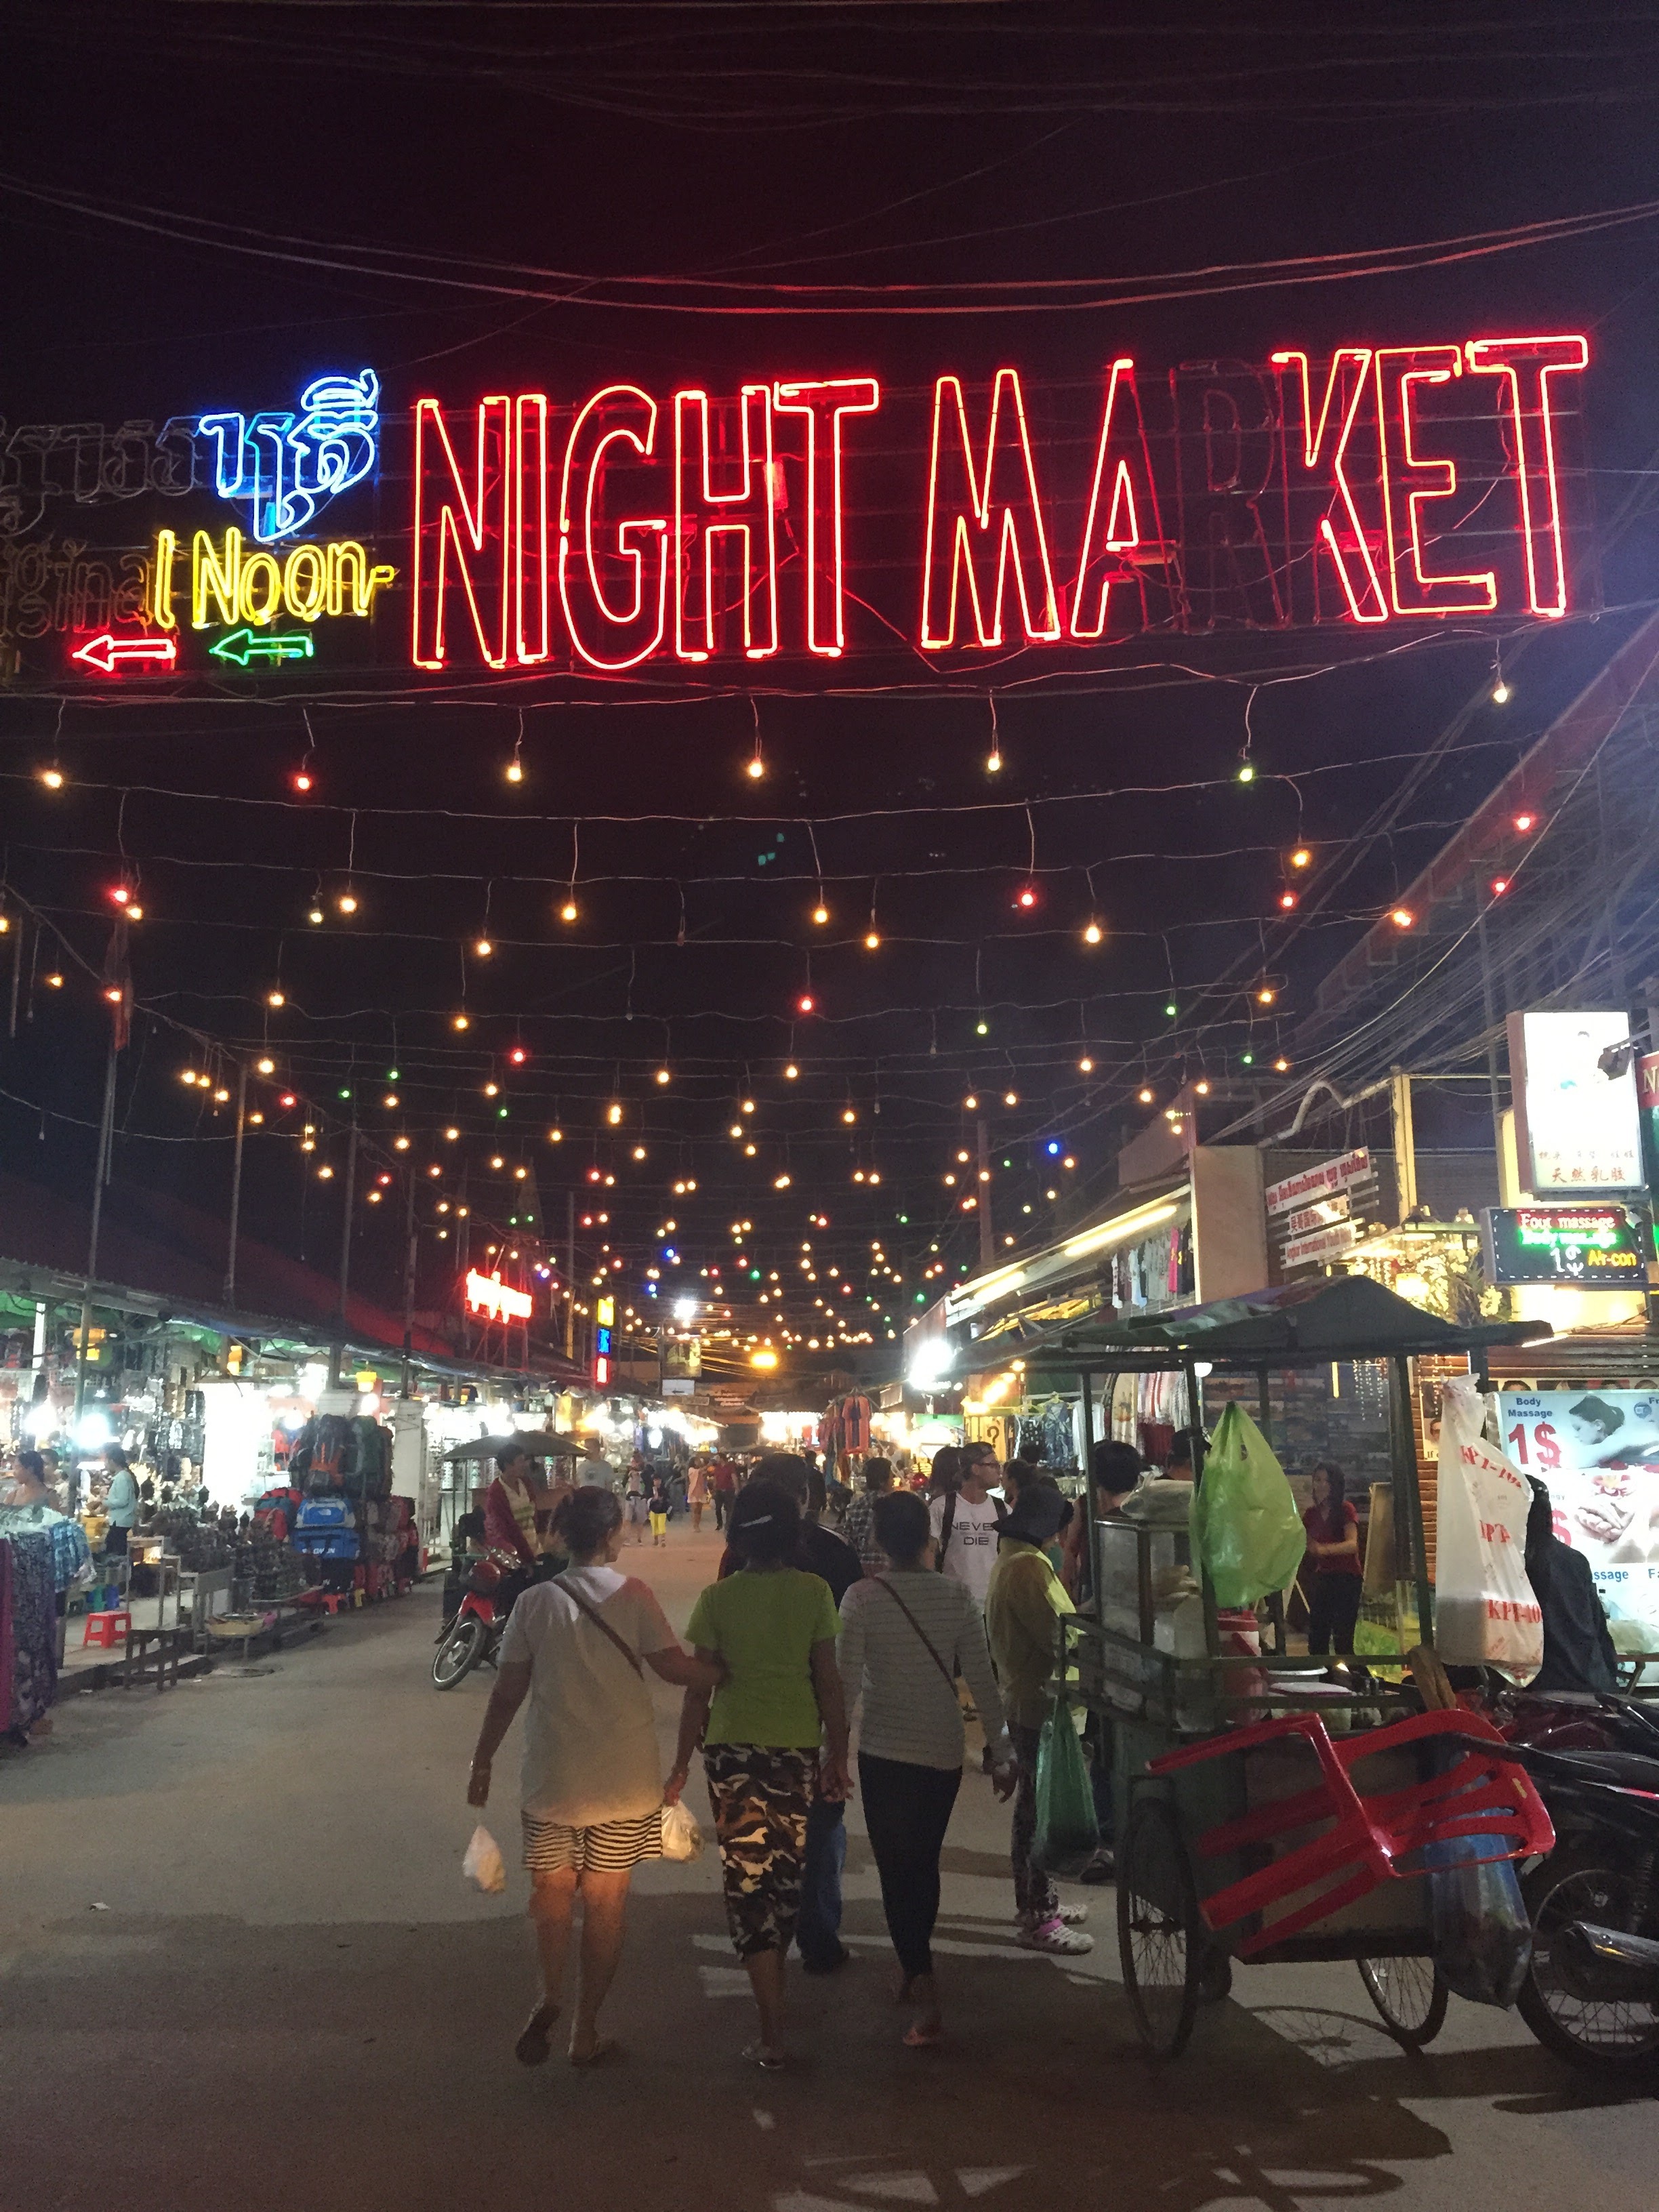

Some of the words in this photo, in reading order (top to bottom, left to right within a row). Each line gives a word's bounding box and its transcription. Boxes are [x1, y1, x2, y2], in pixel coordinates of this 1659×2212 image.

[413, 377, 880, 670] NIGHT
[921, 333, 1590, 651] MARKET
[1552, 1166, 1626, 1183] 天然乳胶
[1558, 1216, 1616, 1232] massage
[1516, 1397, 1541, 1408] Body
[1508, 1409, 1553, 1419] Massage
[1508, 1420, 1561, 1467] 1$
[951, 1521, 995, 1531] NEVE
[963, 1536, 989, 1546] DIE
[1593, 1570, 1629, 1582] ssage
